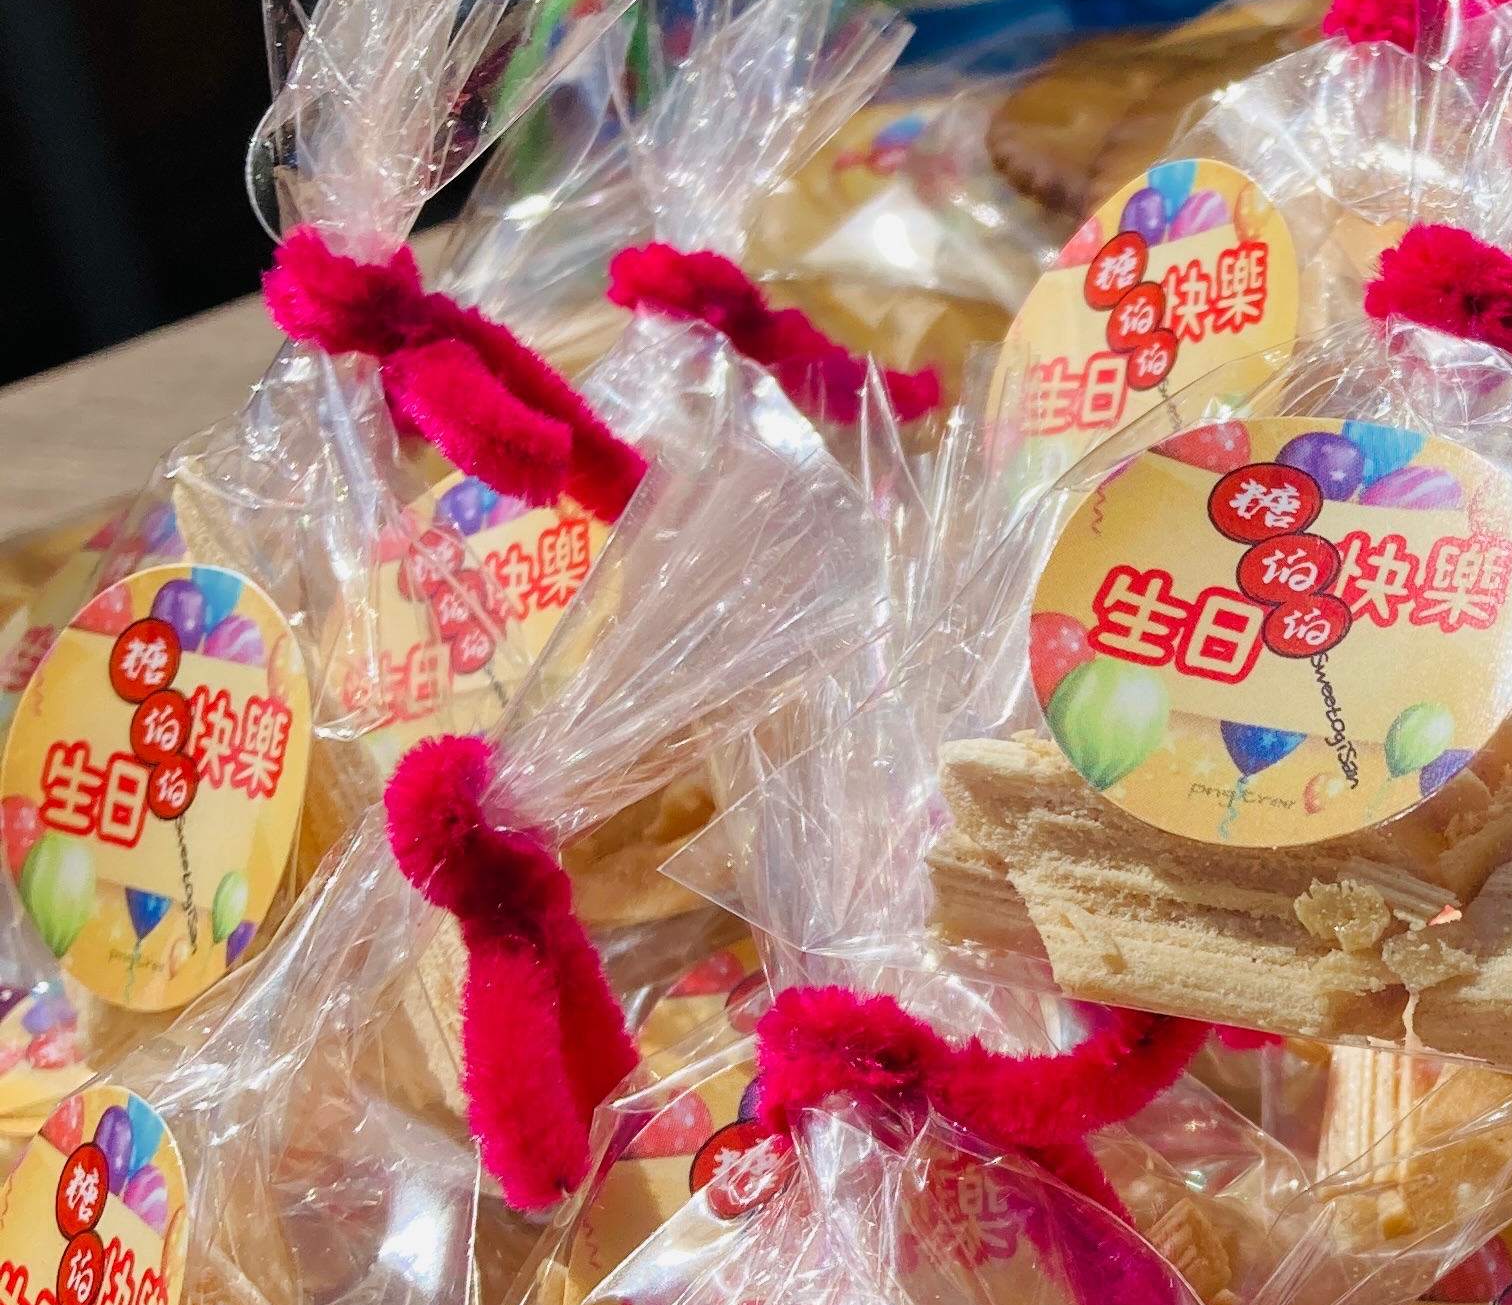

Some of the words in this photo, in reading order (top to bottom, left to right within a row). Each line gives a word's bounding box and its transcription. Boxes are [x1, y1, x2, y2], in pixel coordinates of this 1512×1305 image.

[1019, 351, 1128, 437] 生日
[1159, 241, 1269, 341] 快樂
[1095, 246, 1168, 376] 糖伯伯
[483, 517, 592, 621] 快樂
[1087, 565, 1267, 685] 生日
[1229, 475, 1331, 647] 糖伯伯
[40, 739, 150, 849] 生日
[186, 684, 293, 799] 快樂
[120, 636, 190, 806] 糖伯伯
